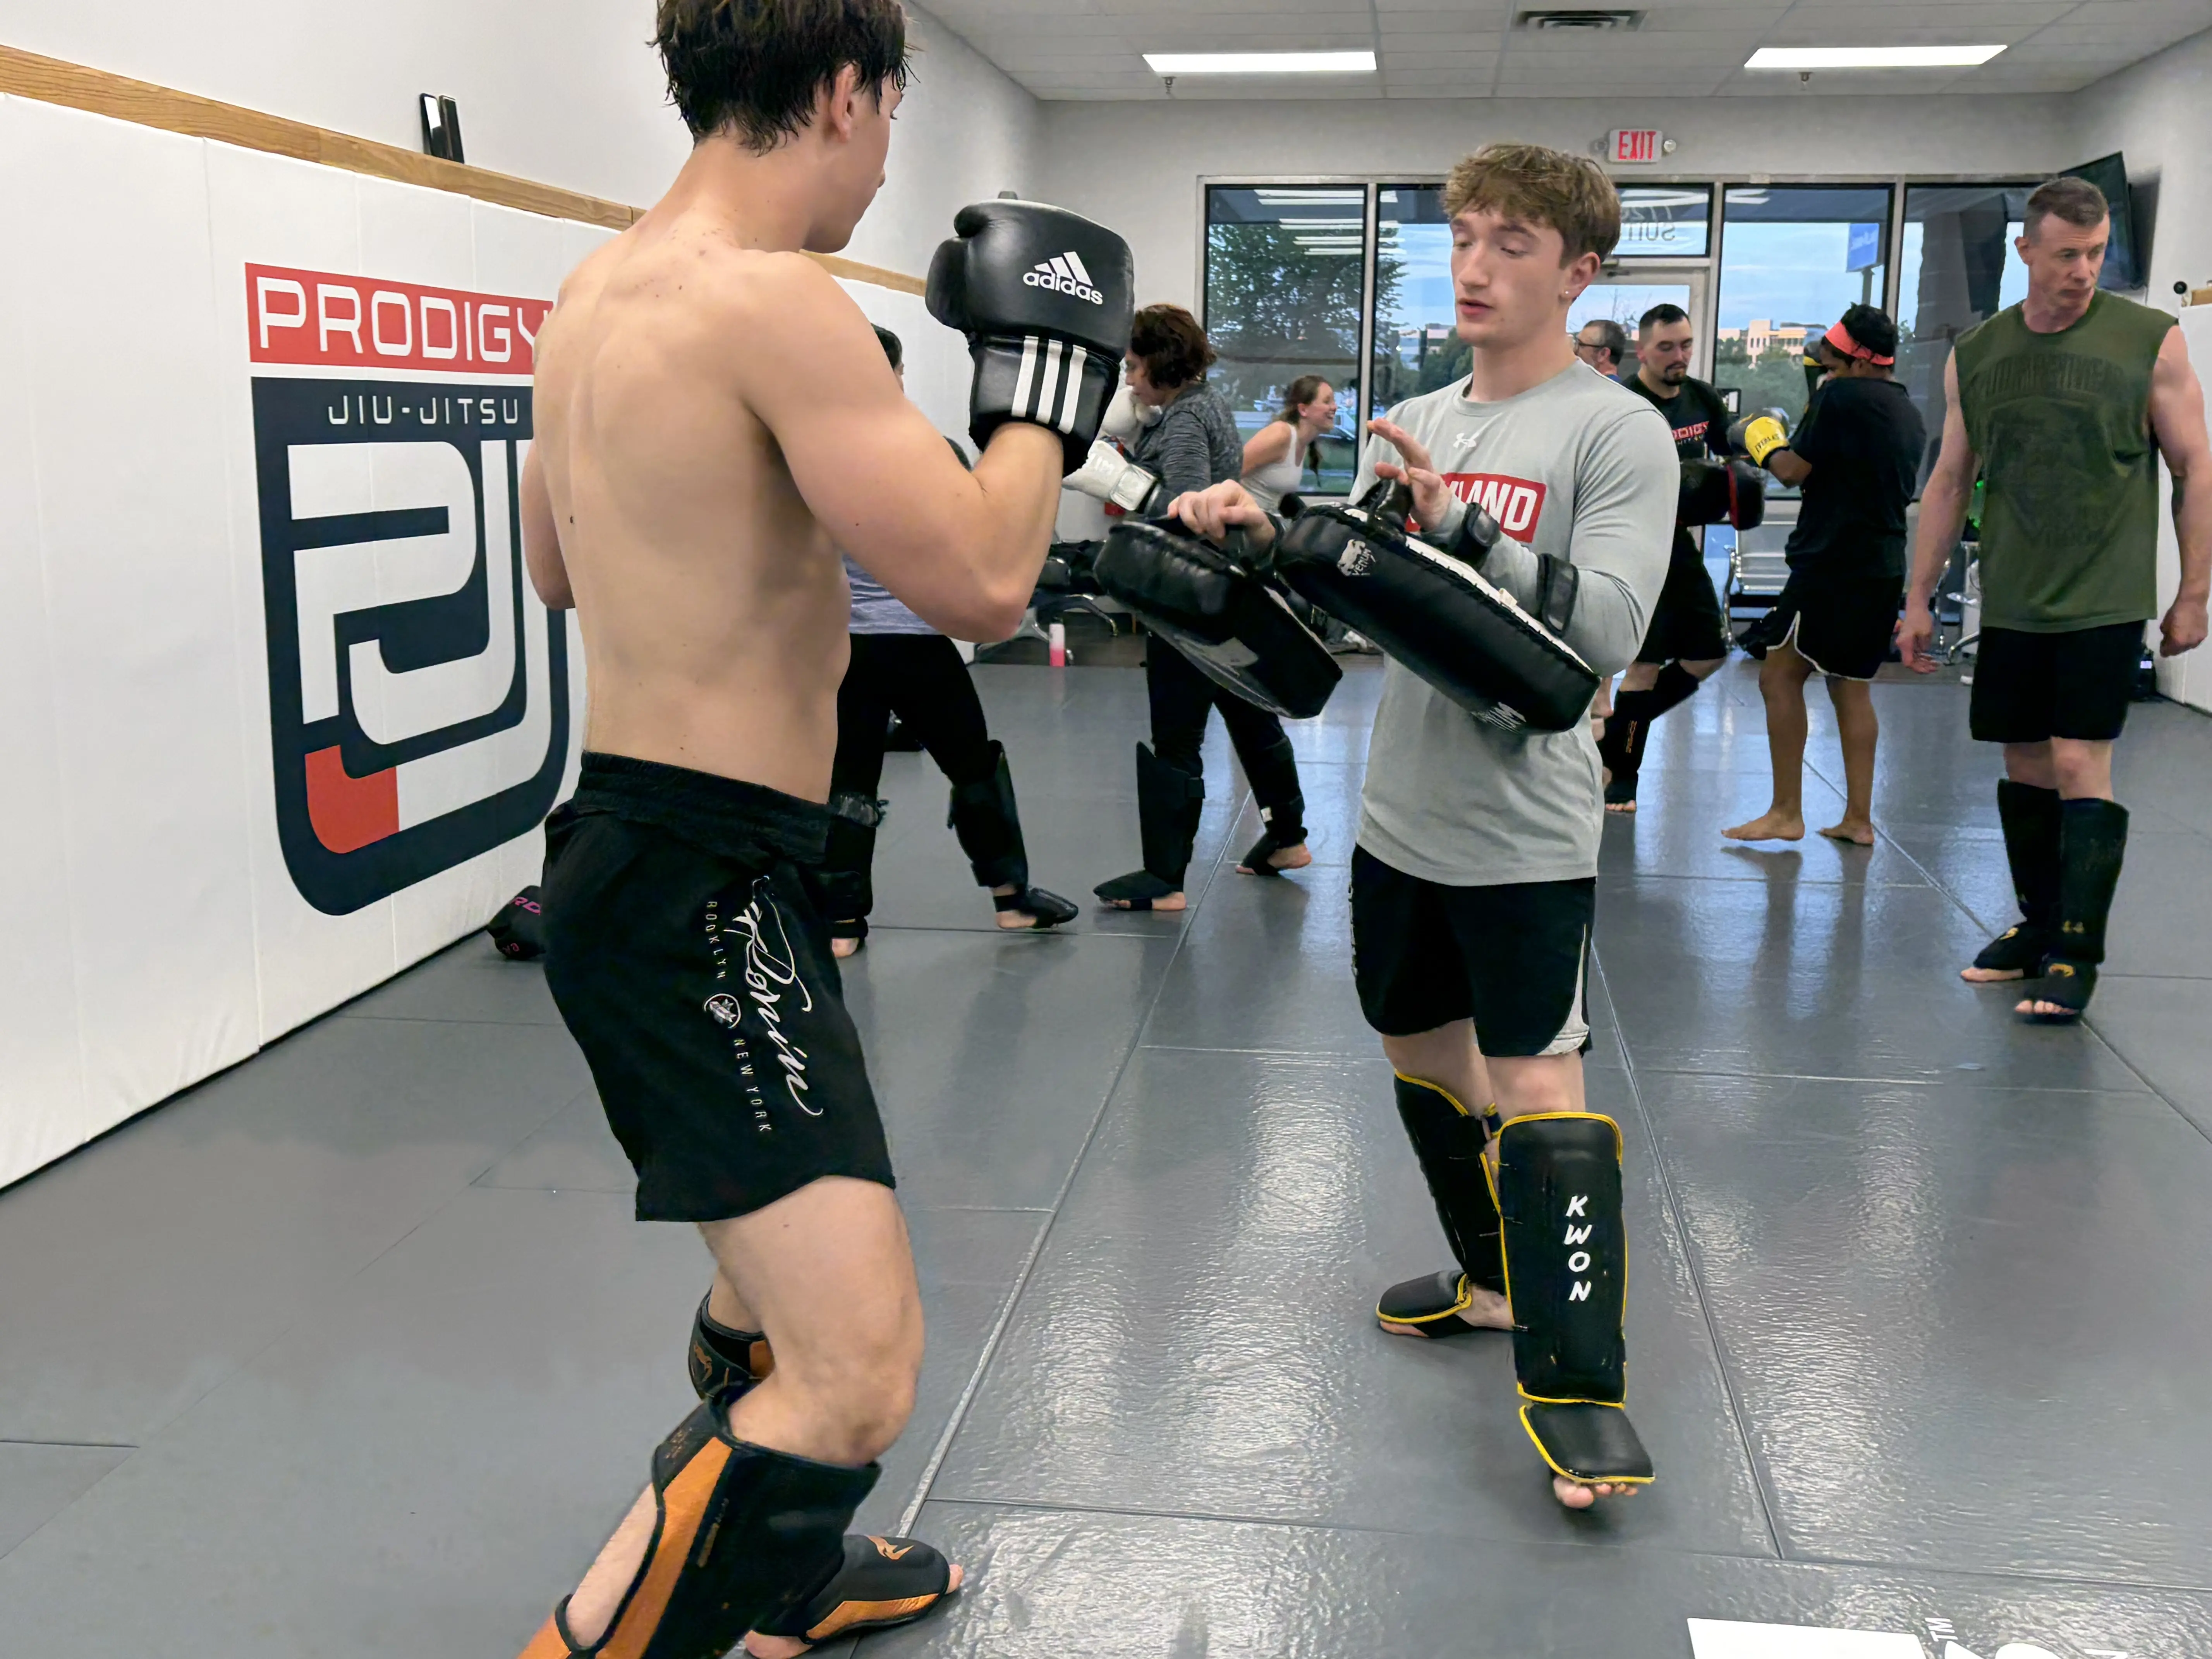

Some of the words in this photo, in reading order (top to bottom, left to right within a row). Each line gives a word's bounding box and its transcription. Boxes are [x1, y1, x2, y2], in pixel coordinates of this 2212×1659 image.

[1618, 131, 1656, 160] EXIT
[1023, 272, 1103, 305] adidas
[256, 276, 548, 362] PRODIGY
[328, 395, 518, 425] JIU-JITSU
[733, 1039, 754, 1076] NEW
[746, 1085, 771, 1132] YORK
[1563, 1195, 1592, 1301] KWON
